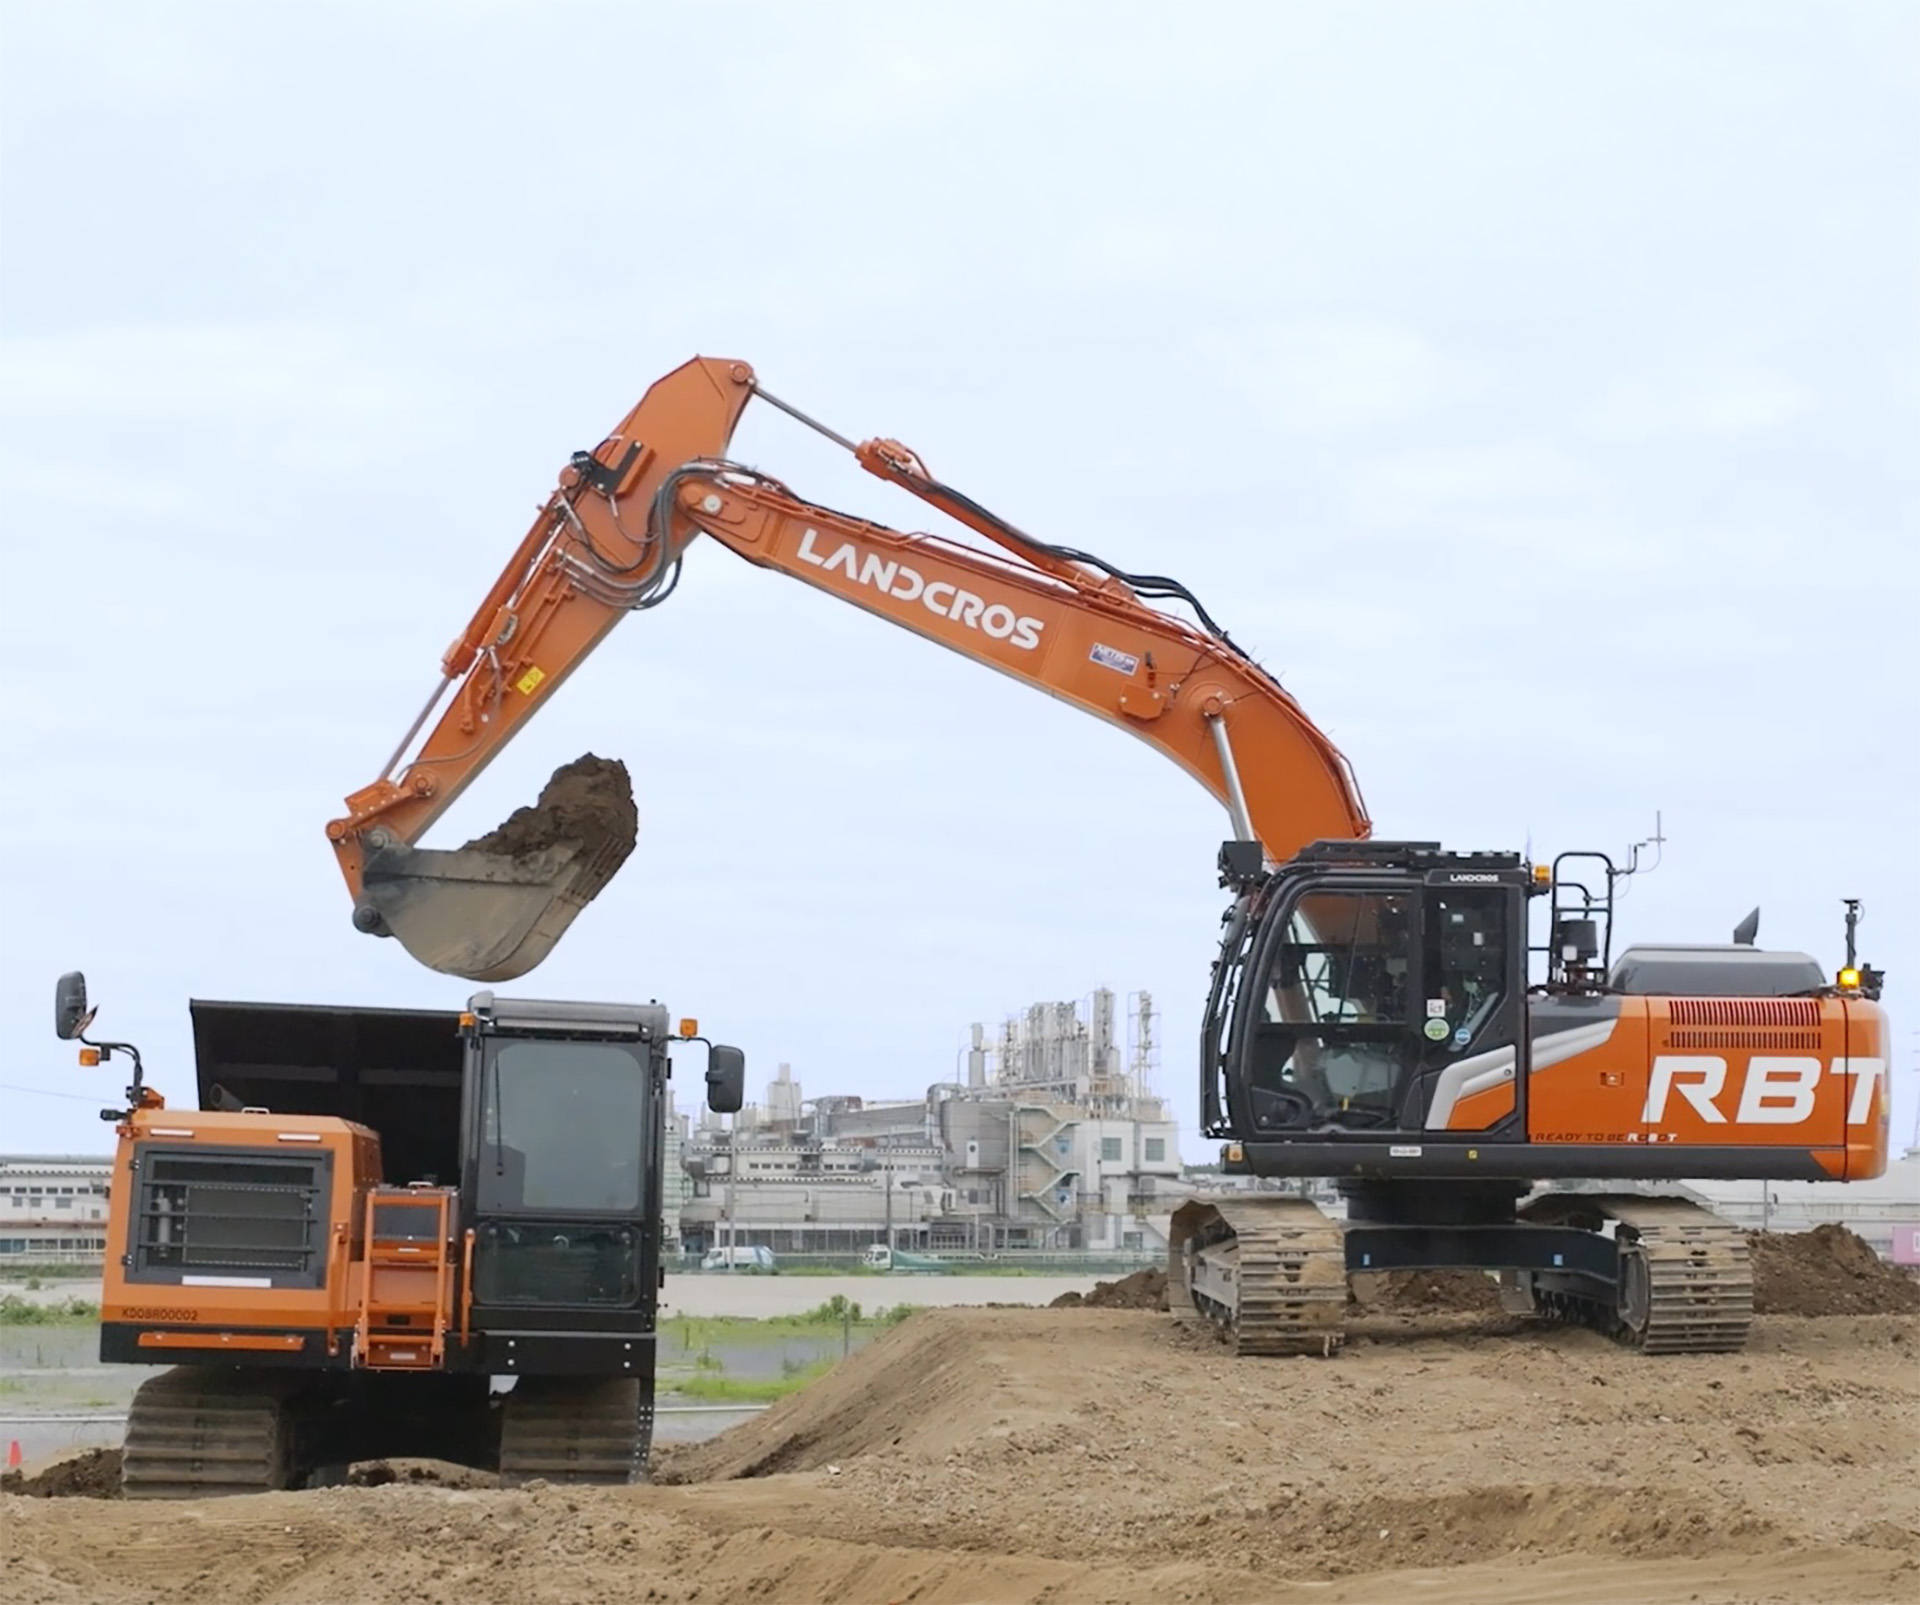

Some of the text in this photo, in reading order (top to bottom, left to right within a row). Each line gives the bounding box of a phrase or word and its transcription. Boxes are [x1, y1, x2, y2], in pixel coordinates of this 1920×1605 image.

[796, 528, 1045, 650] LANDCROS
[1640, 1055, 1886, 1125] RBT
[1535, 1132, 1678, 1142] READY TO BE ROBOT
